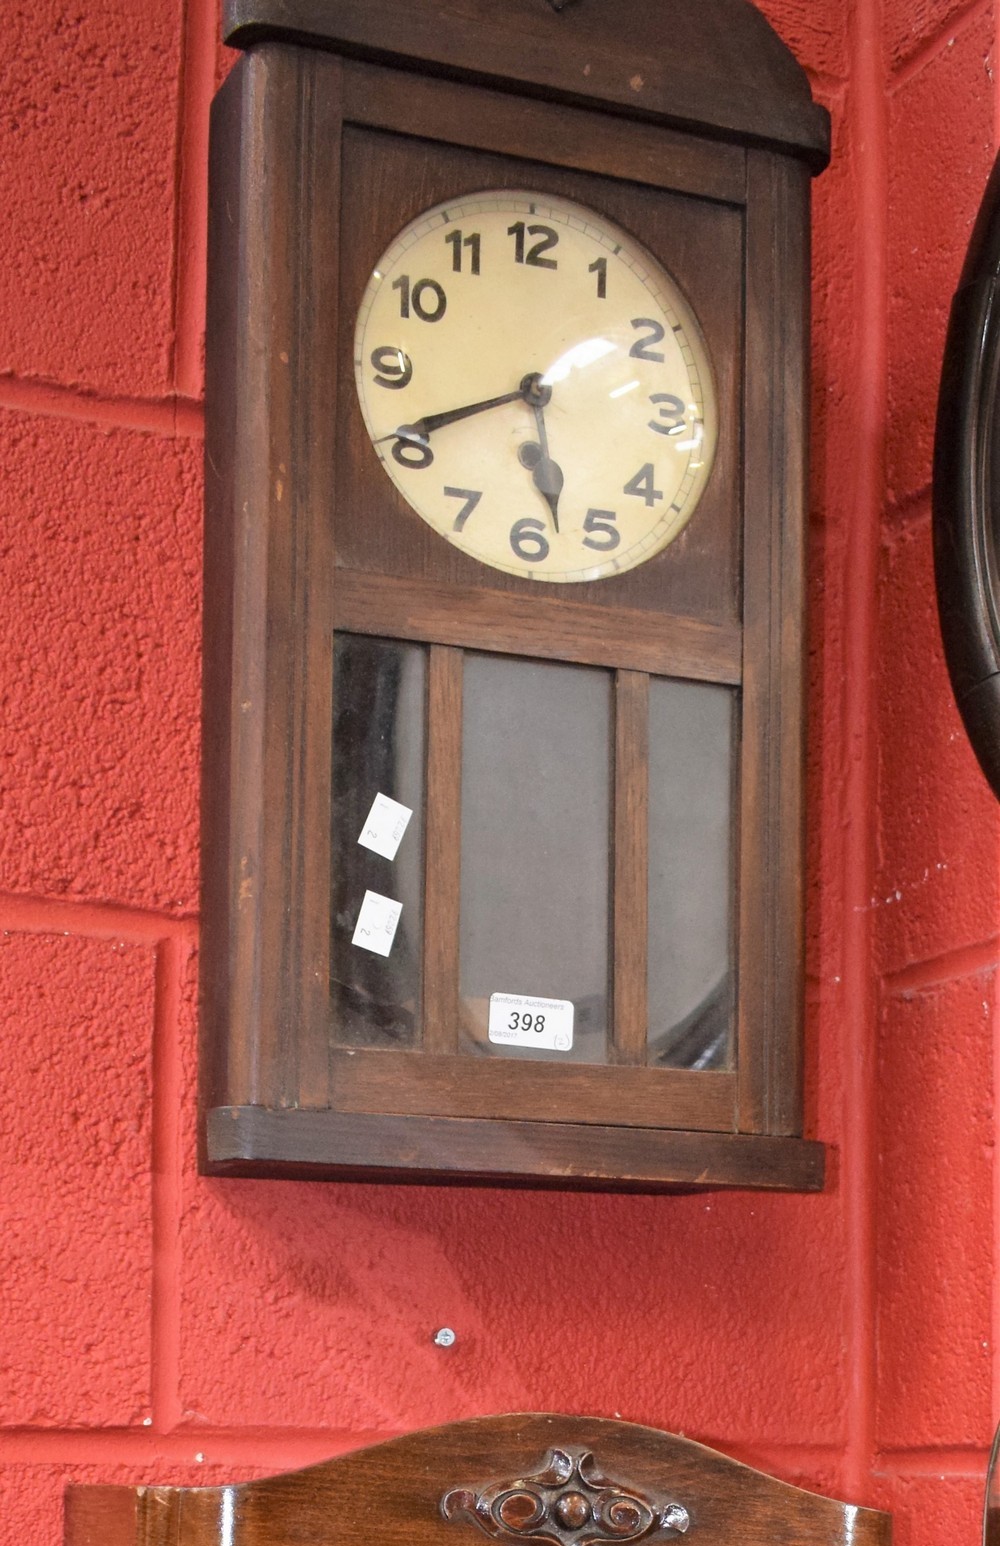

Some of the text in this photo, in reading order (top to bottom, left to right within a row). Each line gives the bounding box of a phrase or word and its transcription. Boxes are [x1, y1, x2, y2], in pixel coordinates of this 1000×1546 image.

[445, 229, 481, 276] 11
[507, 221, 559, 270] 12
[392, 275, 447, 323] 10
[588, 257, 607, 299] 1
[629, 318, 665, 363] 2
[370, 345, 412, 390] 9
[647, 392, 686, 435] 3
[623, 463, 664, 507] 4
[443, 486, 483, 532] 7
[582, 508, 621, 552] 5
[509, 518, 550, 562] 6
[508, 1012, 545, 1033] 398
